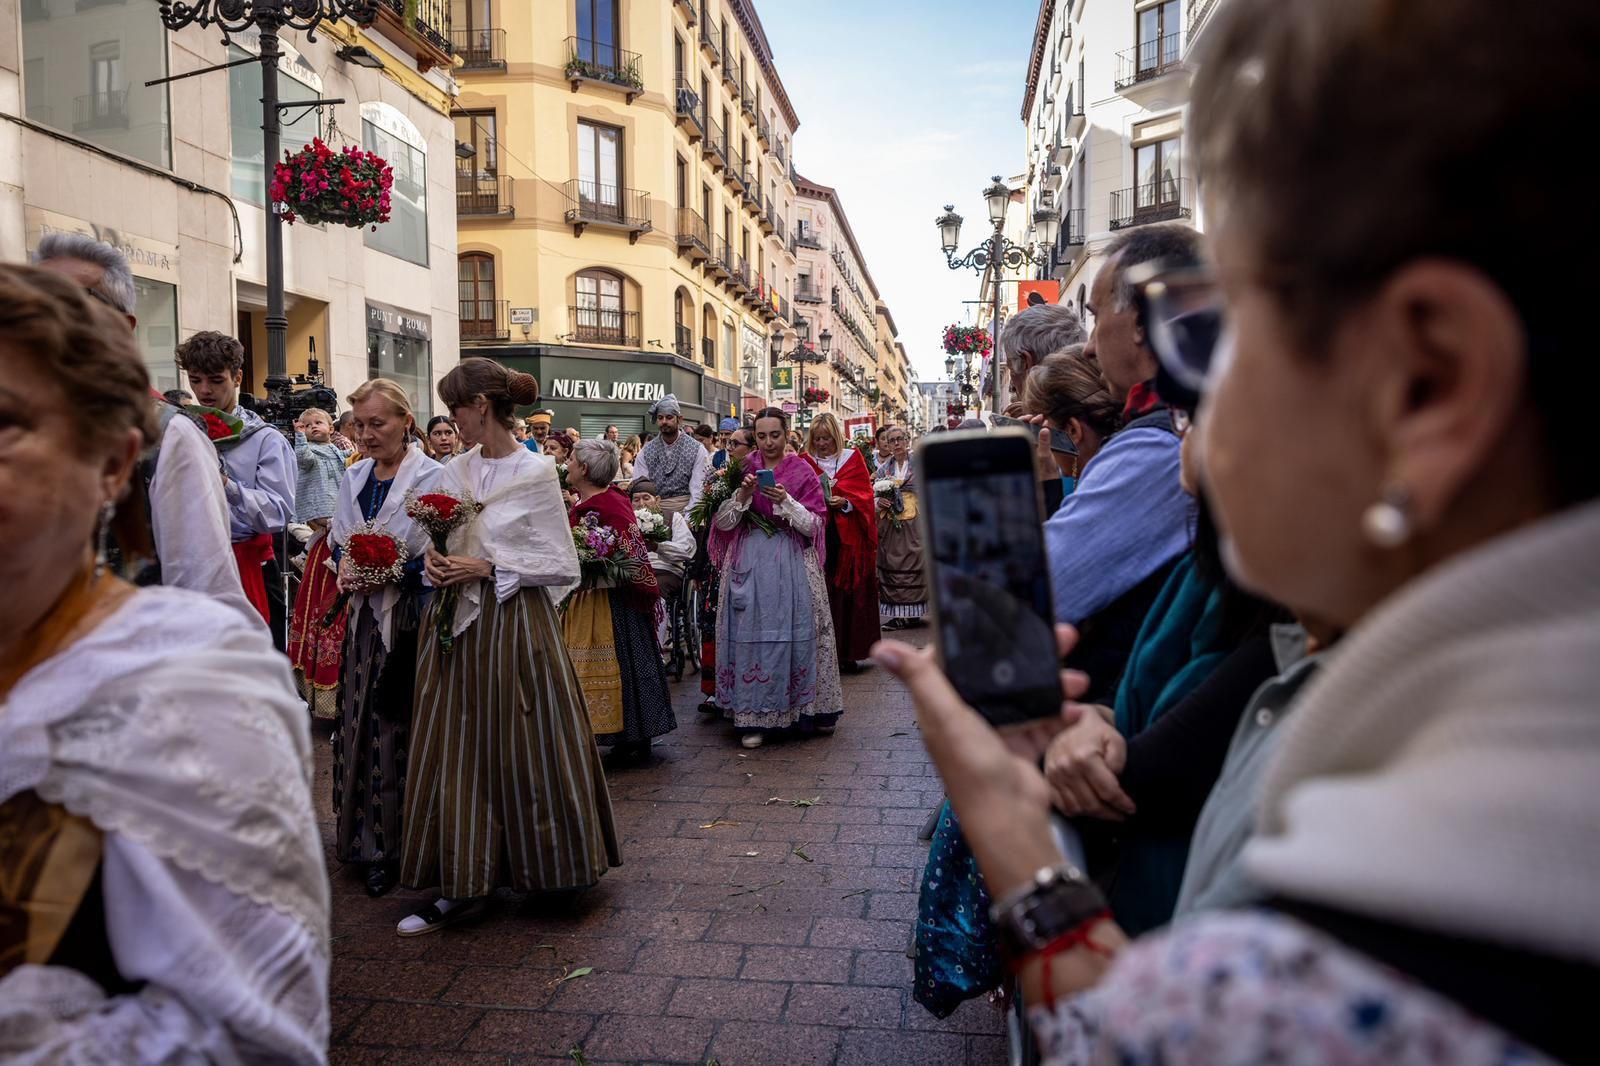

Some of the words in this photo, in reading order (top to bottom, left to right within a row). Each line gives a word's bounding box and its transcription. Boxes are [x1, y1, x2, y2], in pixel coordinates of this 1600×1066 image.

[371, 309, 393, 324] PUNT
[406, 318, 428, 333] ROMA
[551, 379, 601, 399] NUEVA
[608, 381, 665, 401] JOYERIA
